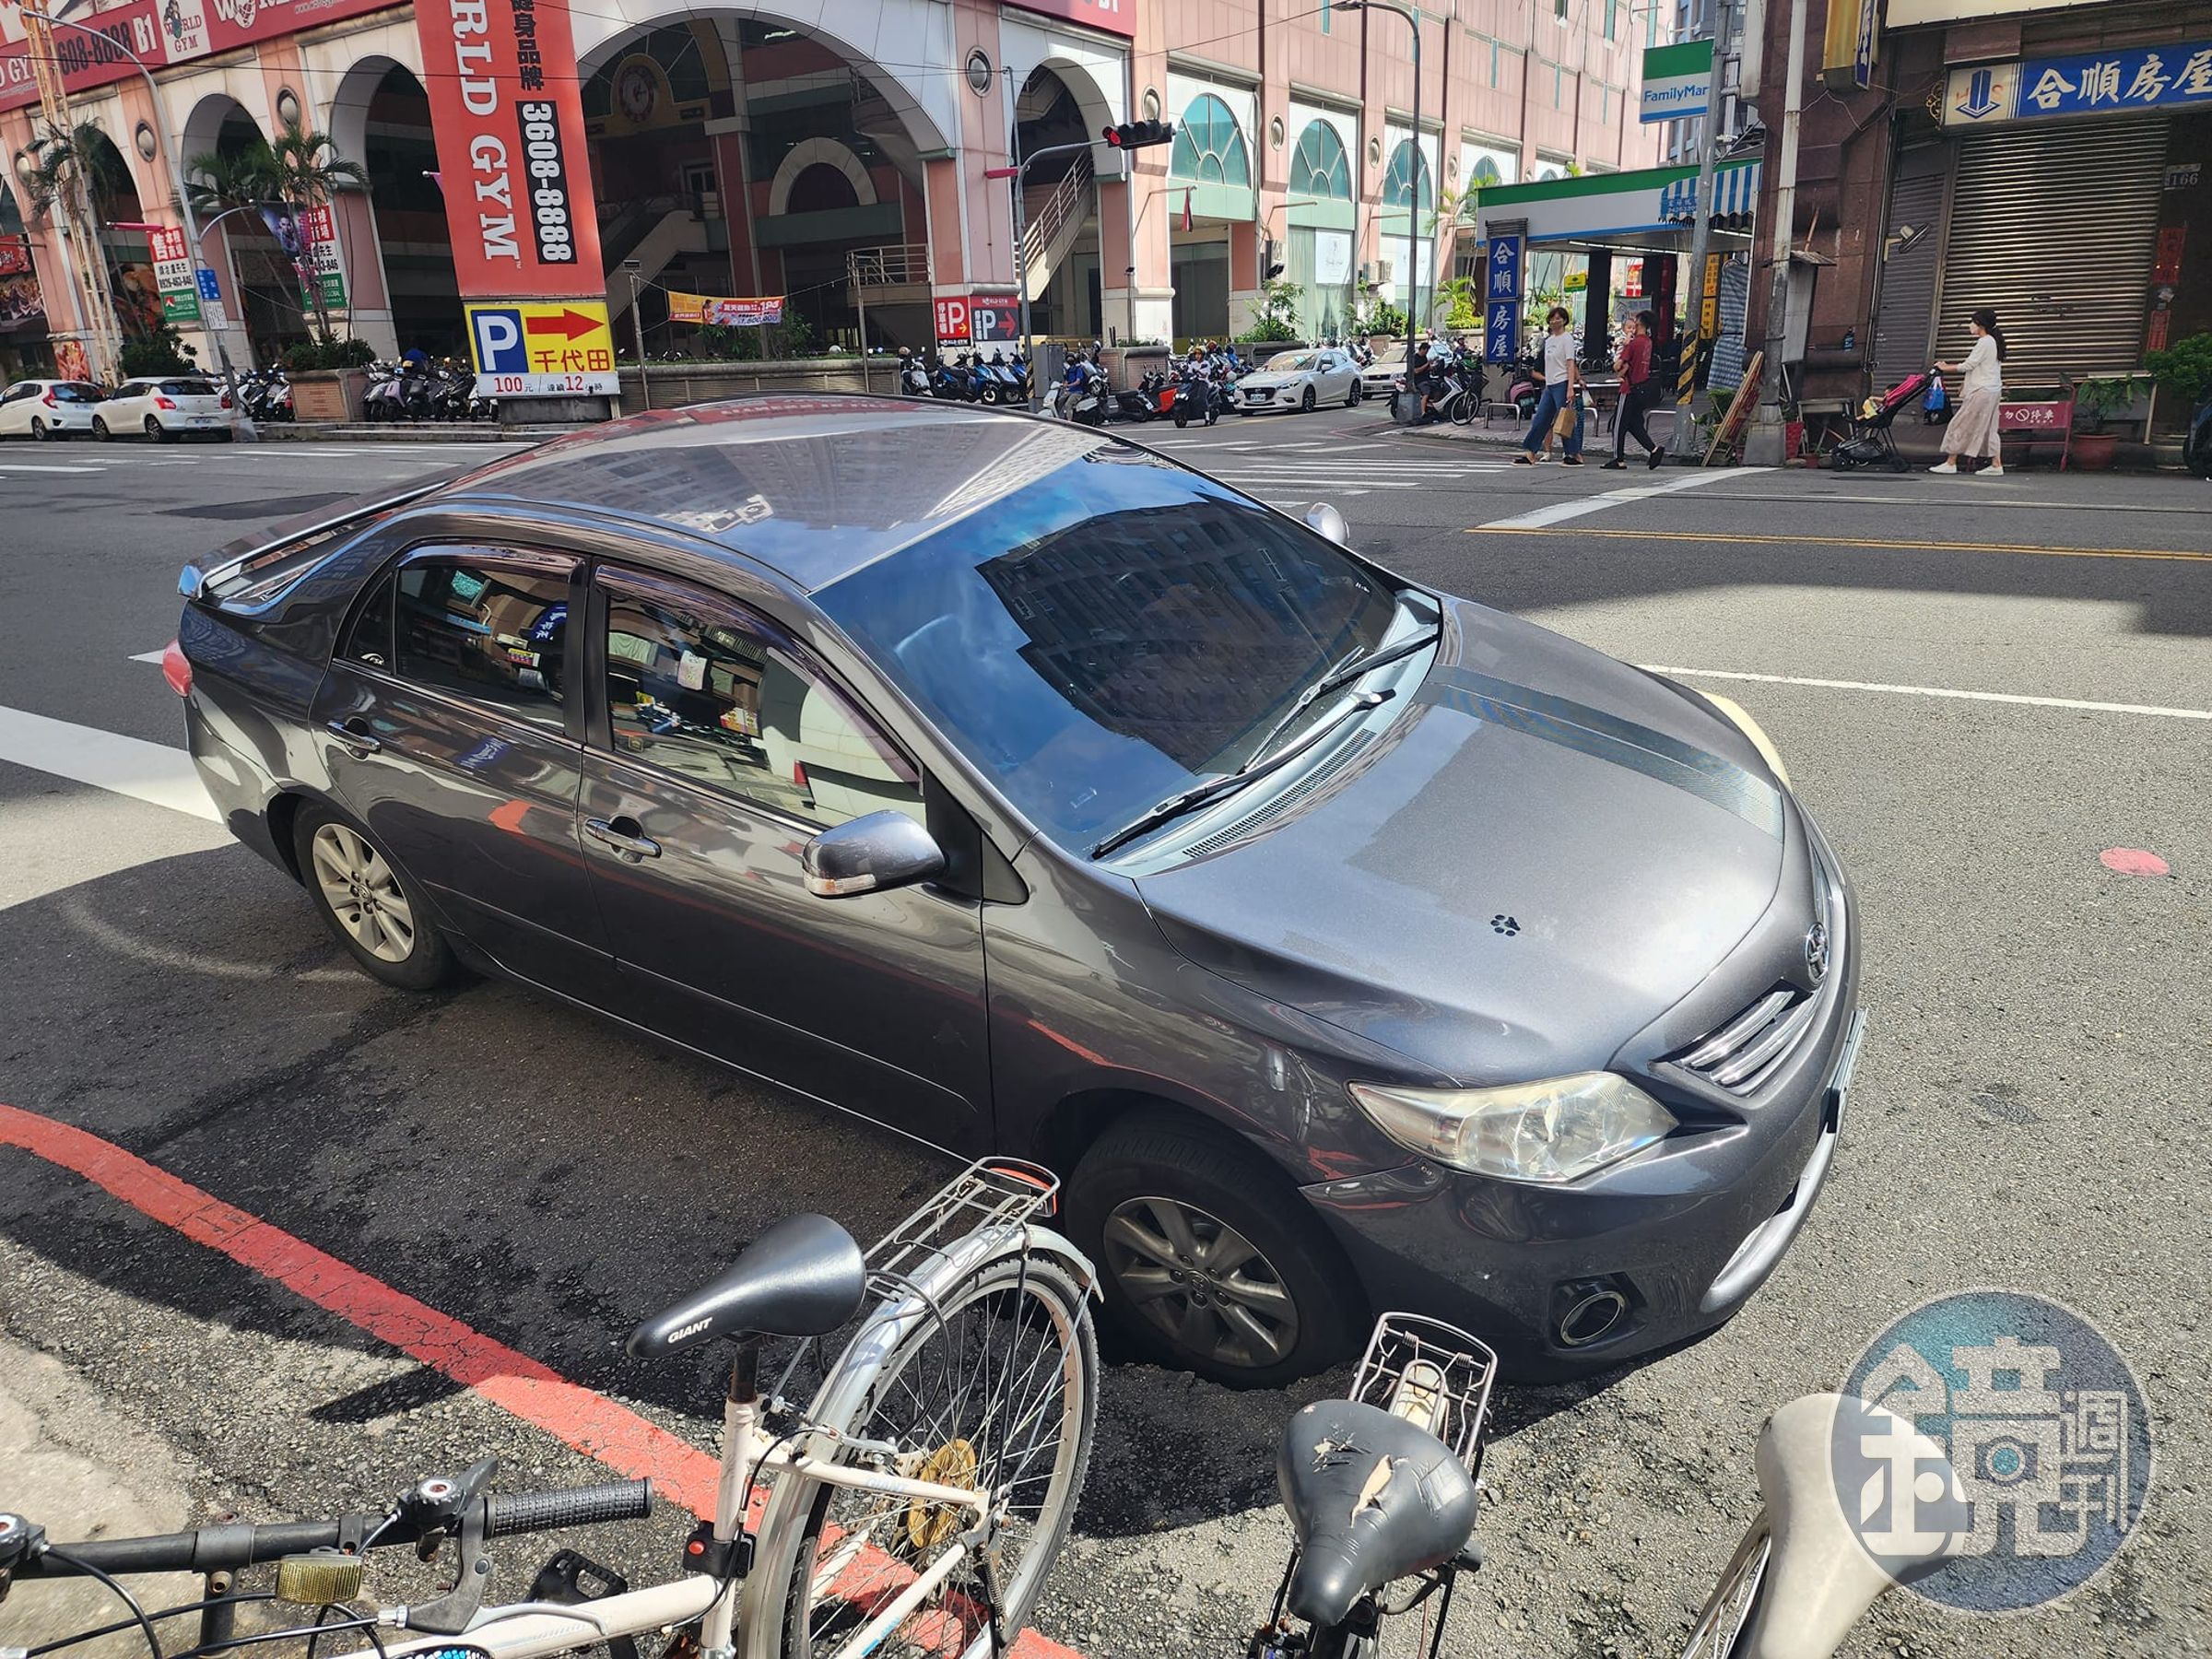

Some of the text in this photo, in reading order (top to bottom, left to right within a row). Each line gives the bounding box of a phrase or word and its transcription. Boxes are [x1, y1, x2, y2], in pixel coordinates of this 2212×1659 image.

[7, 53, 41, 83] GY
[133, 14, 158, 54] B1
[174, 35, 199, 53] GYM
[1643, 84, 1711, 103] FamilyMar
[2027, 48, 2212, 110] 合順房屋
[470, 134, 520, 260] GYM
[522, 102, 572, 261] 3608-8888
[947, 302, 965, 334] P
[1491, 241, 1515, 357] 合順房屋
[477, 315, 518, 371] P
[982, 310, 996, 340] P
[534, 348, 612, 372] 千代田
[667, 1317, 713, 1344] GIANT
